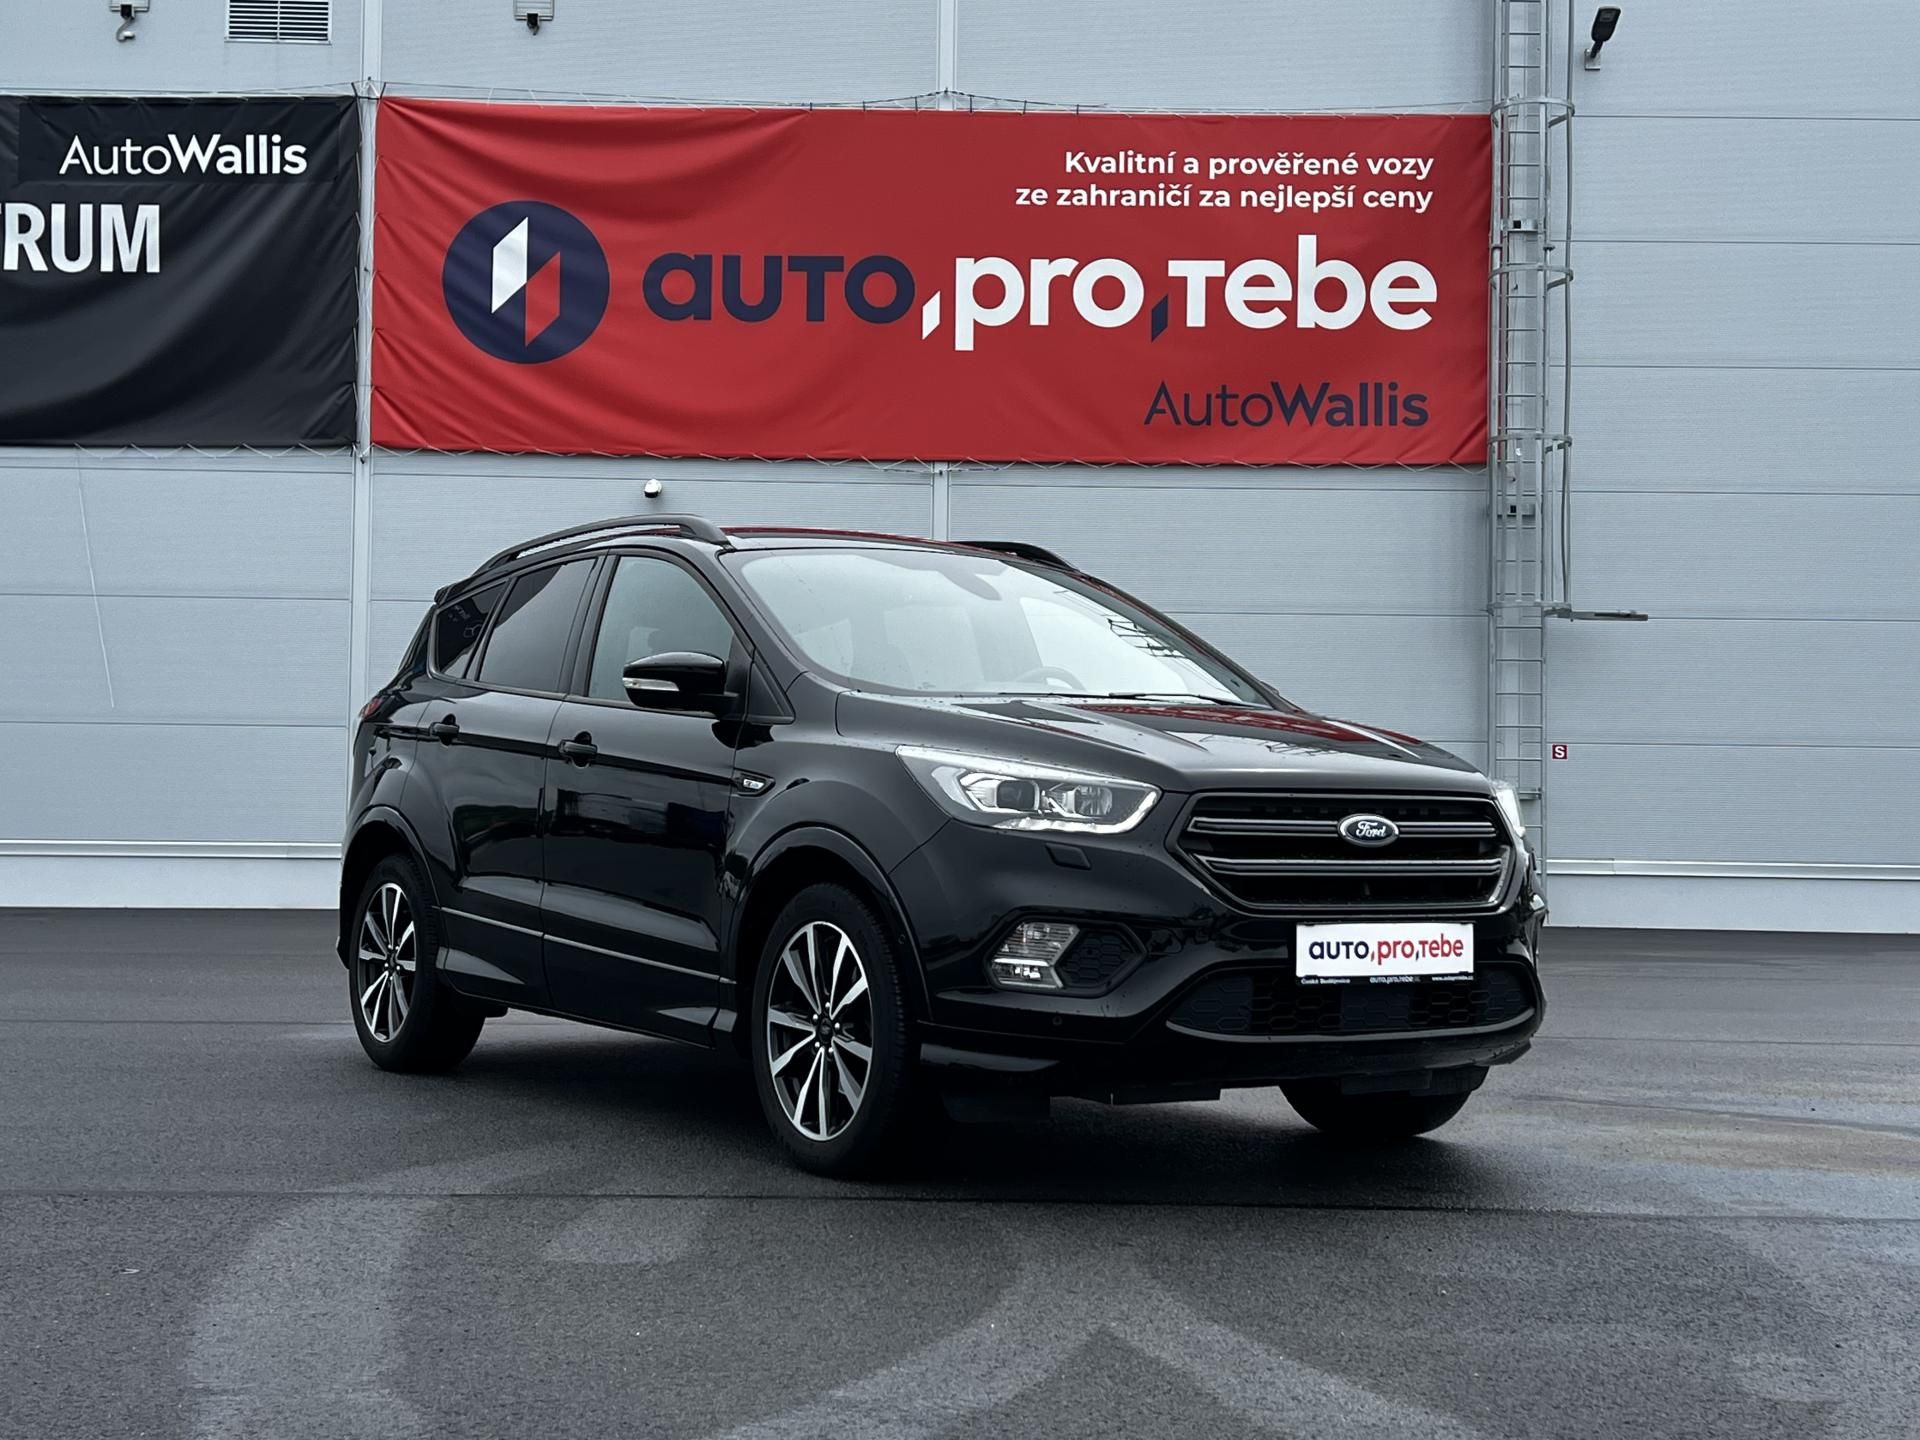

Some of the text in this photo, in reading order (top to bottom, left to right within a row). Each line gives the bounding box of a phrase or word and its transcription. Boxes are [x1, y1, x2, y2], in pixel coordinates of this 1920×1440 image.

[60, 134, 306, 174] AutoWallis
[1066, 150, 1433, 180] Kvalitní a prověřené vozy
[1016, 183, 1433, 213] ze zahraničí za nejlepší ceny
[0, 203, 159, 272] RUM
[1144, 382, 1428, 426] AutoWallis
[1555, 746, 1565, 758] S
[1356, 821, 1386, 837] Ford
